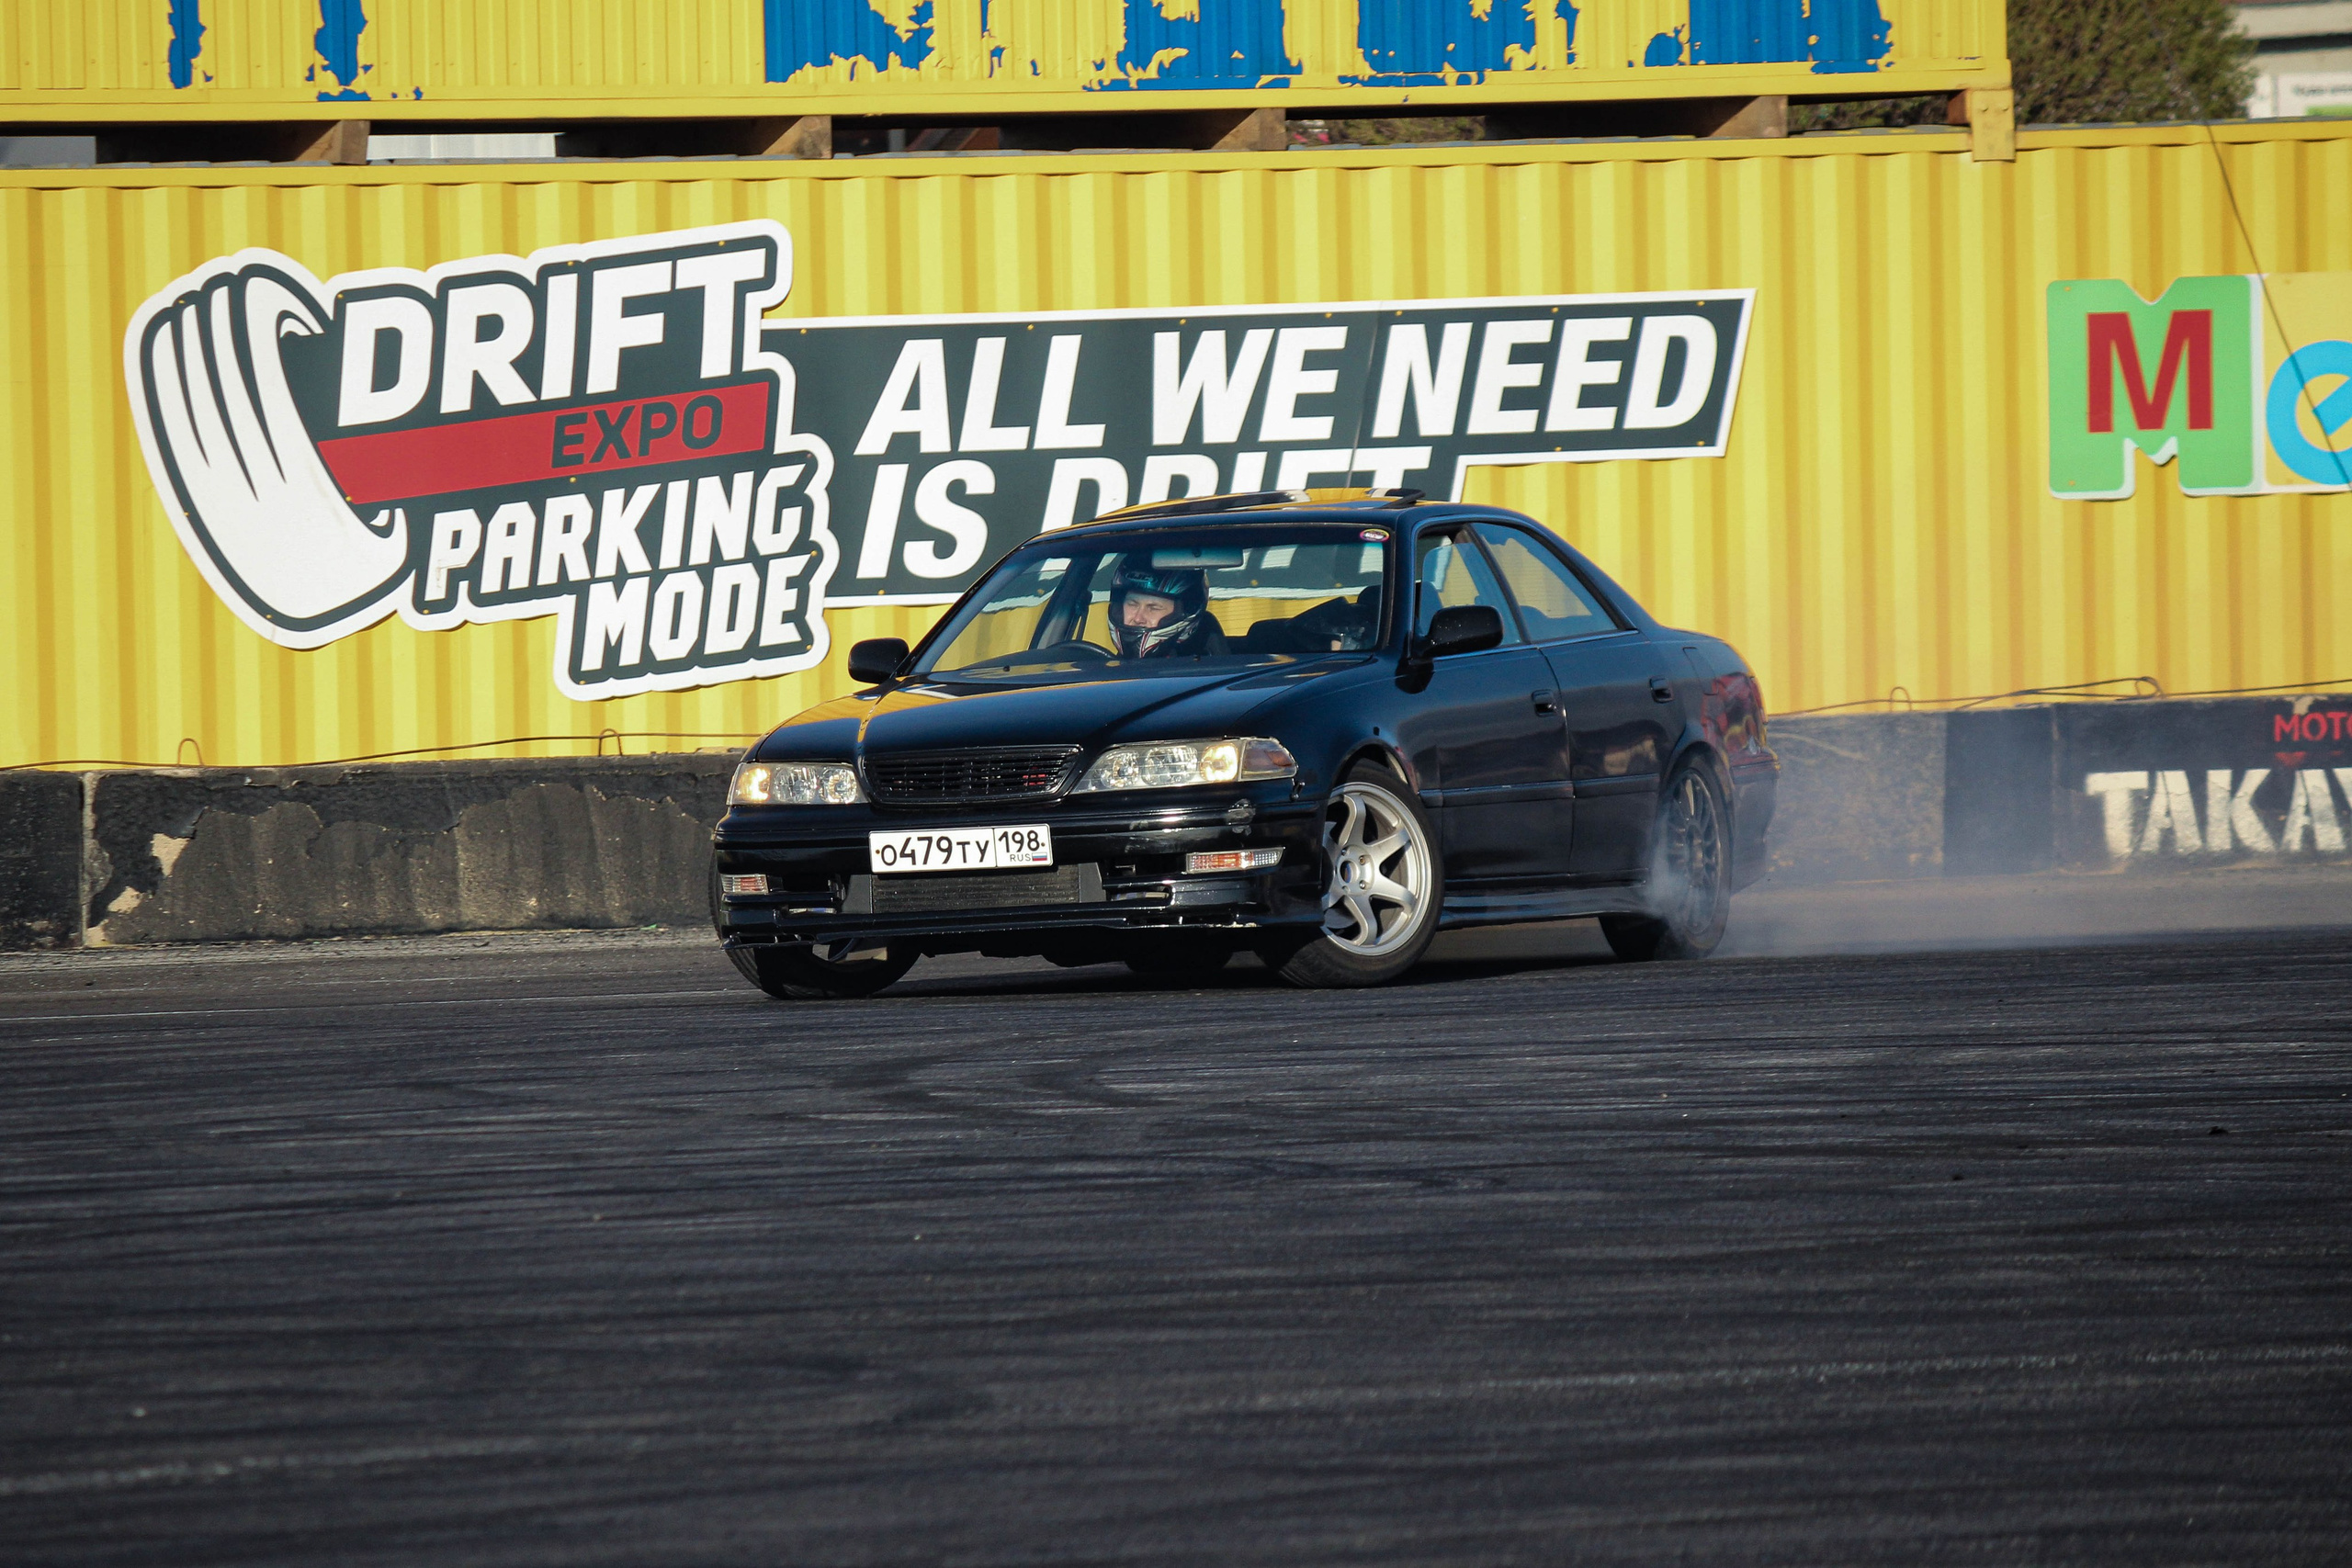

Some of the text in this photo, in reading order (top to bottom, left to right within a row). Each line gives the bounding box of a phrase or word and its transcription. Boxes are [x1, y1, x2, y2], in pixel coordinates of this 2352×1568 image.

[337, 247, 765, 427] DRIFT
[854, 314, 1716, 456] ALL WE NEED
[551, 395, 724, 468] EXPO
[424, 463, 810, 602] PARKING
[855, 459, 996, 581] IS
[581, 553, 815, 672] MODE
[2274, 711, 2352, 742] MOT
[998, 829, 1040, 853] 198
[1010, 852, 1032, 863] RUS
